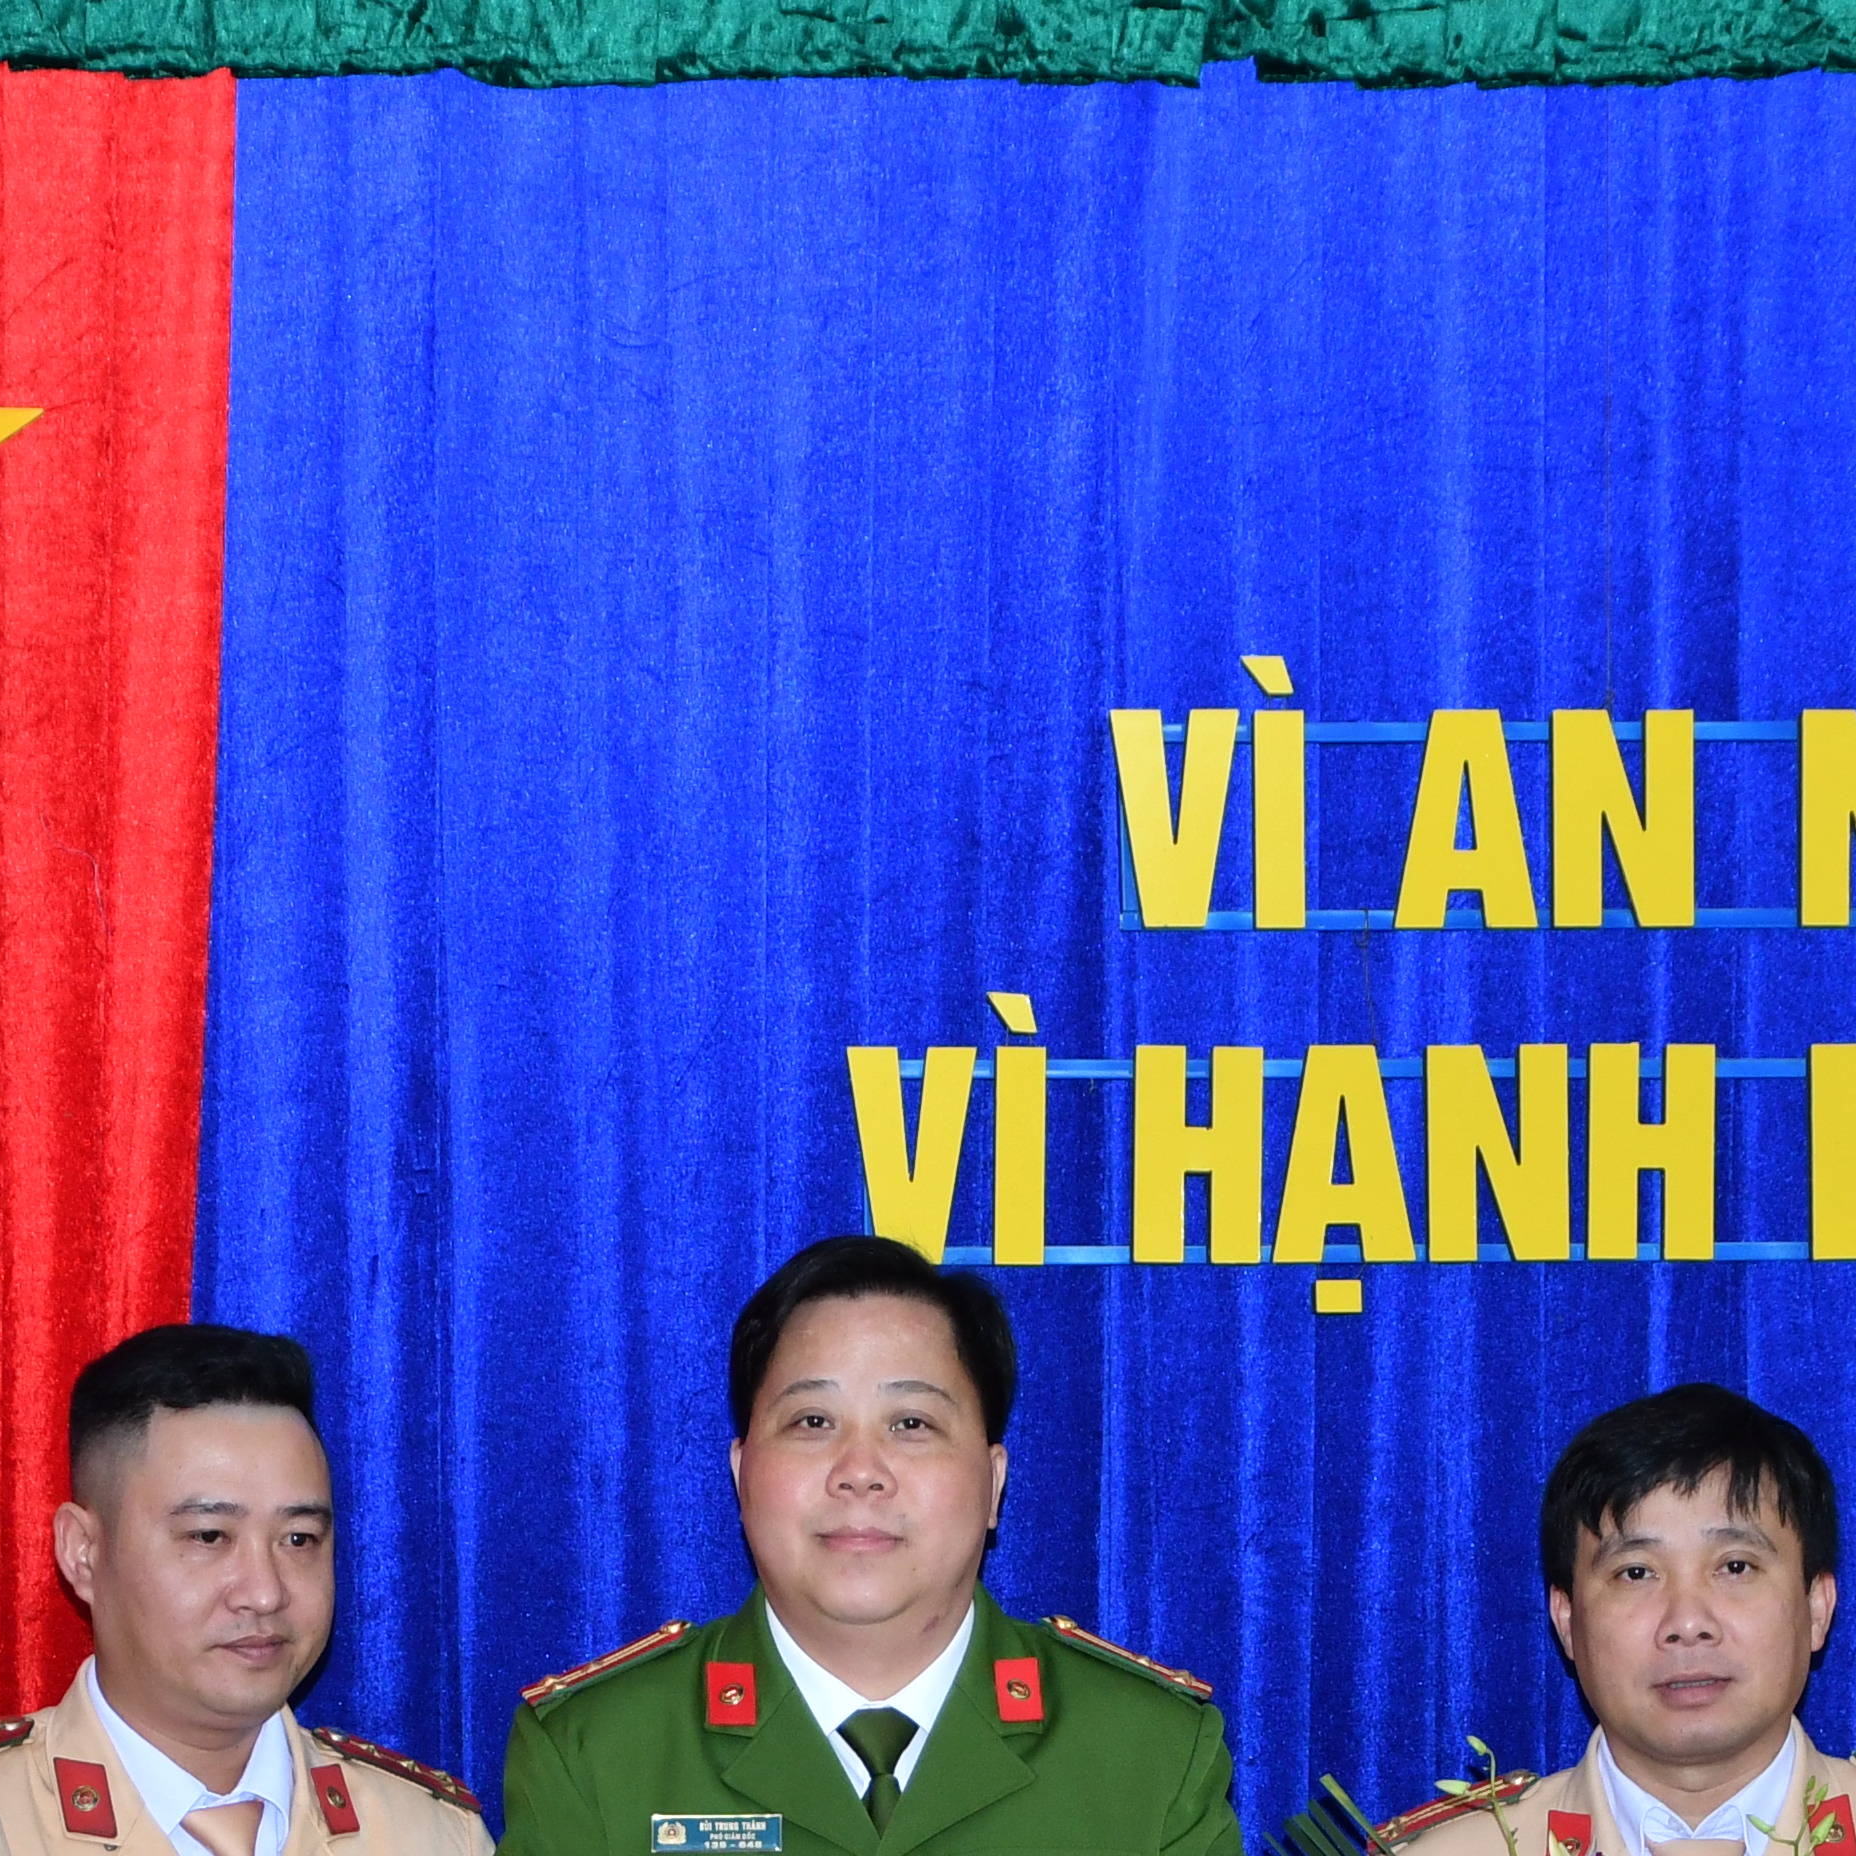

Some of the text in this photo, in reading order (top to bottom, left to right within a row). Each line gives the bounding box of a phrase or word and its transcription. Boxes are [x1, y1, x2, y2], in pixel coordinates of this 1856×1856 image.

[1110, 655, 1304, 929] VÌ
[1397, 711, 1696, 929] AN
[846, 990, 1047, 1265] VÌ
[1133, 1043, 1716, 1313] HẠNH
